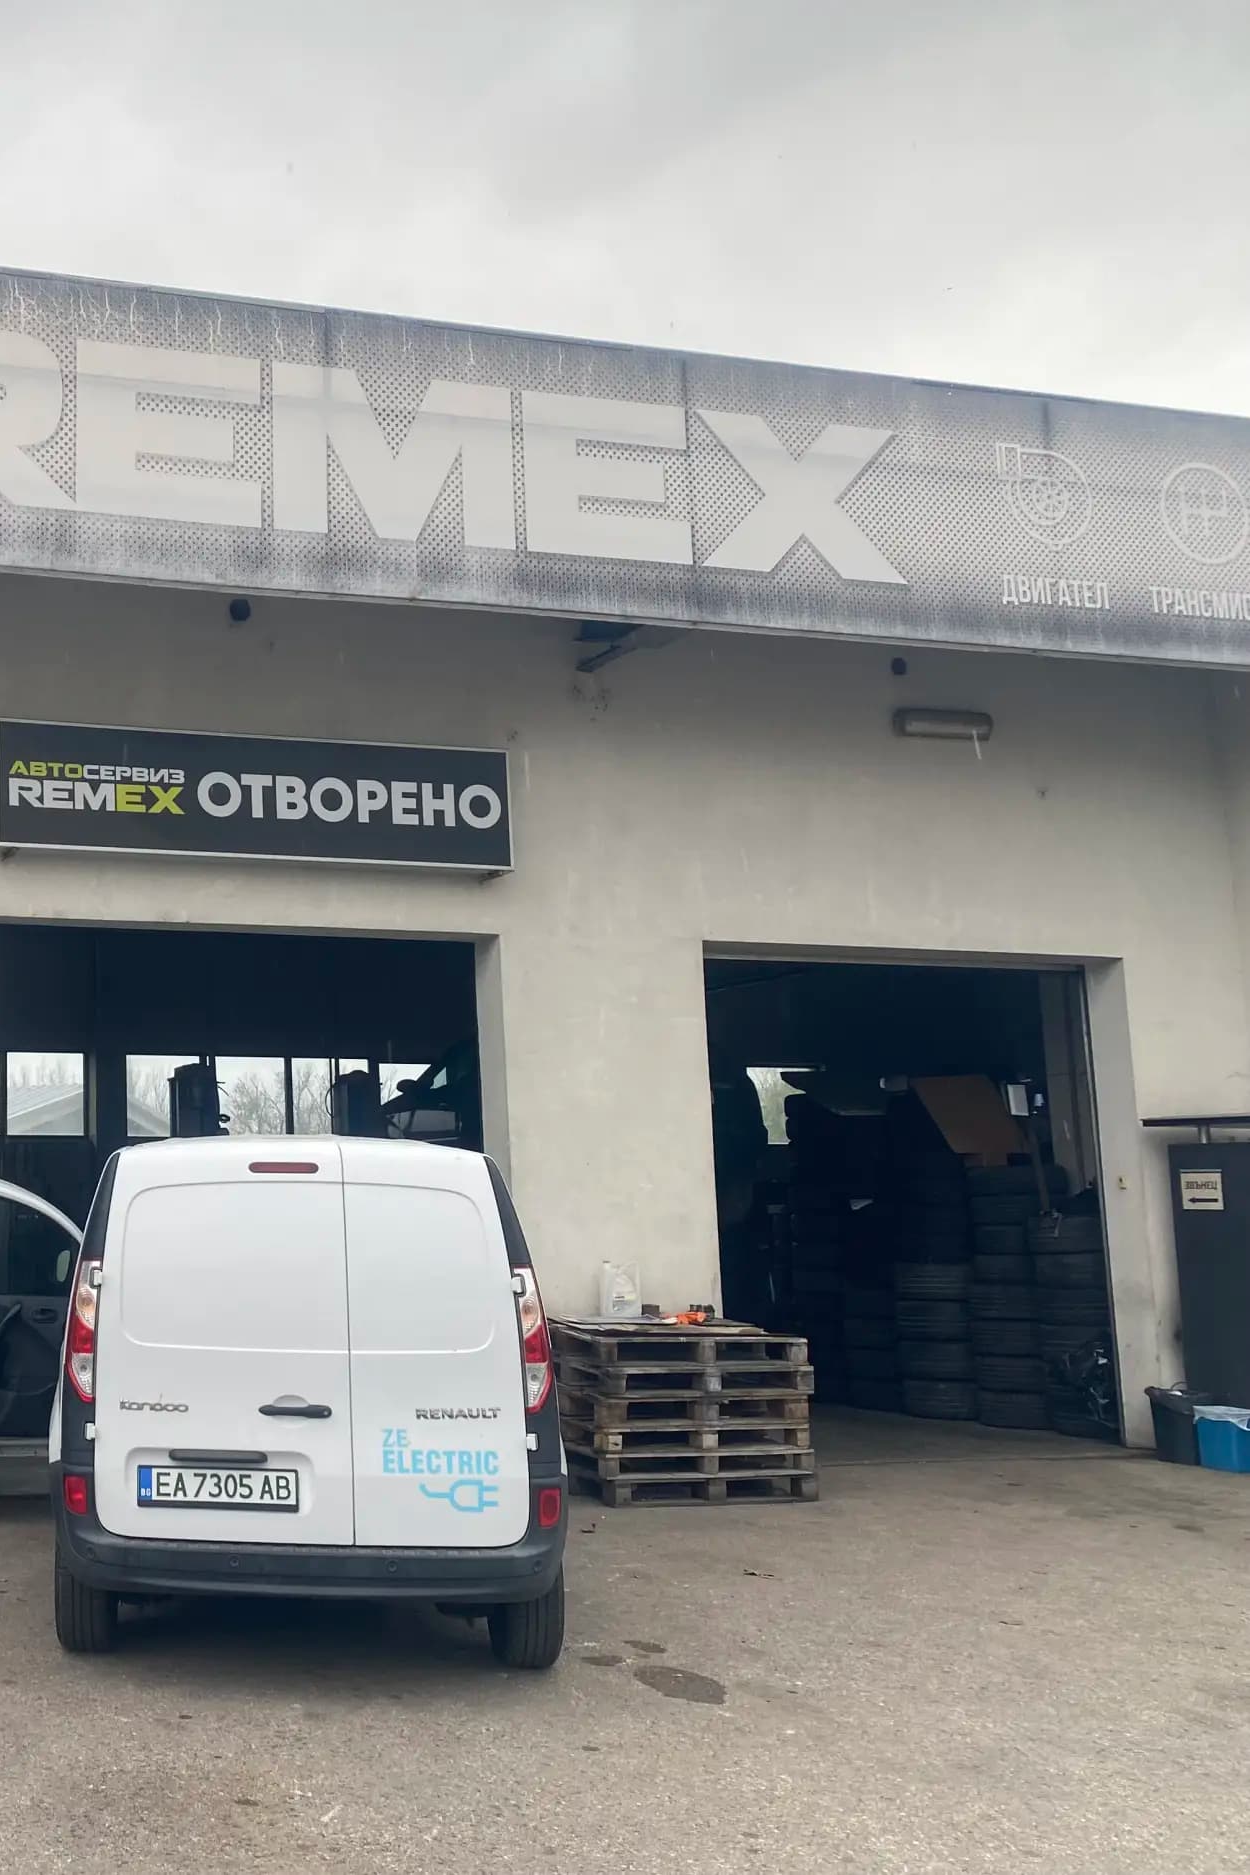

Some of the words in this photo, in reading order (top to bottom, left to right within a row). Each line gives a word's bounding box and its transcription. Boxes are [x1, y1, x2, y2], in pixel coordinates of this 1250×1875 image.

[1003, 574, 1110, 609] ДВИГАТЕЛ
[9, 760, 185, 784] АВТОСЕРВИЗ
[8, 777, 186, 815] REMEX
[197, 771, 502, 829] ОТВОРЕНО
[415, 1407, 501, 1420] RENAULT
[382, 1449, 499, 1475] ELECTRIC
